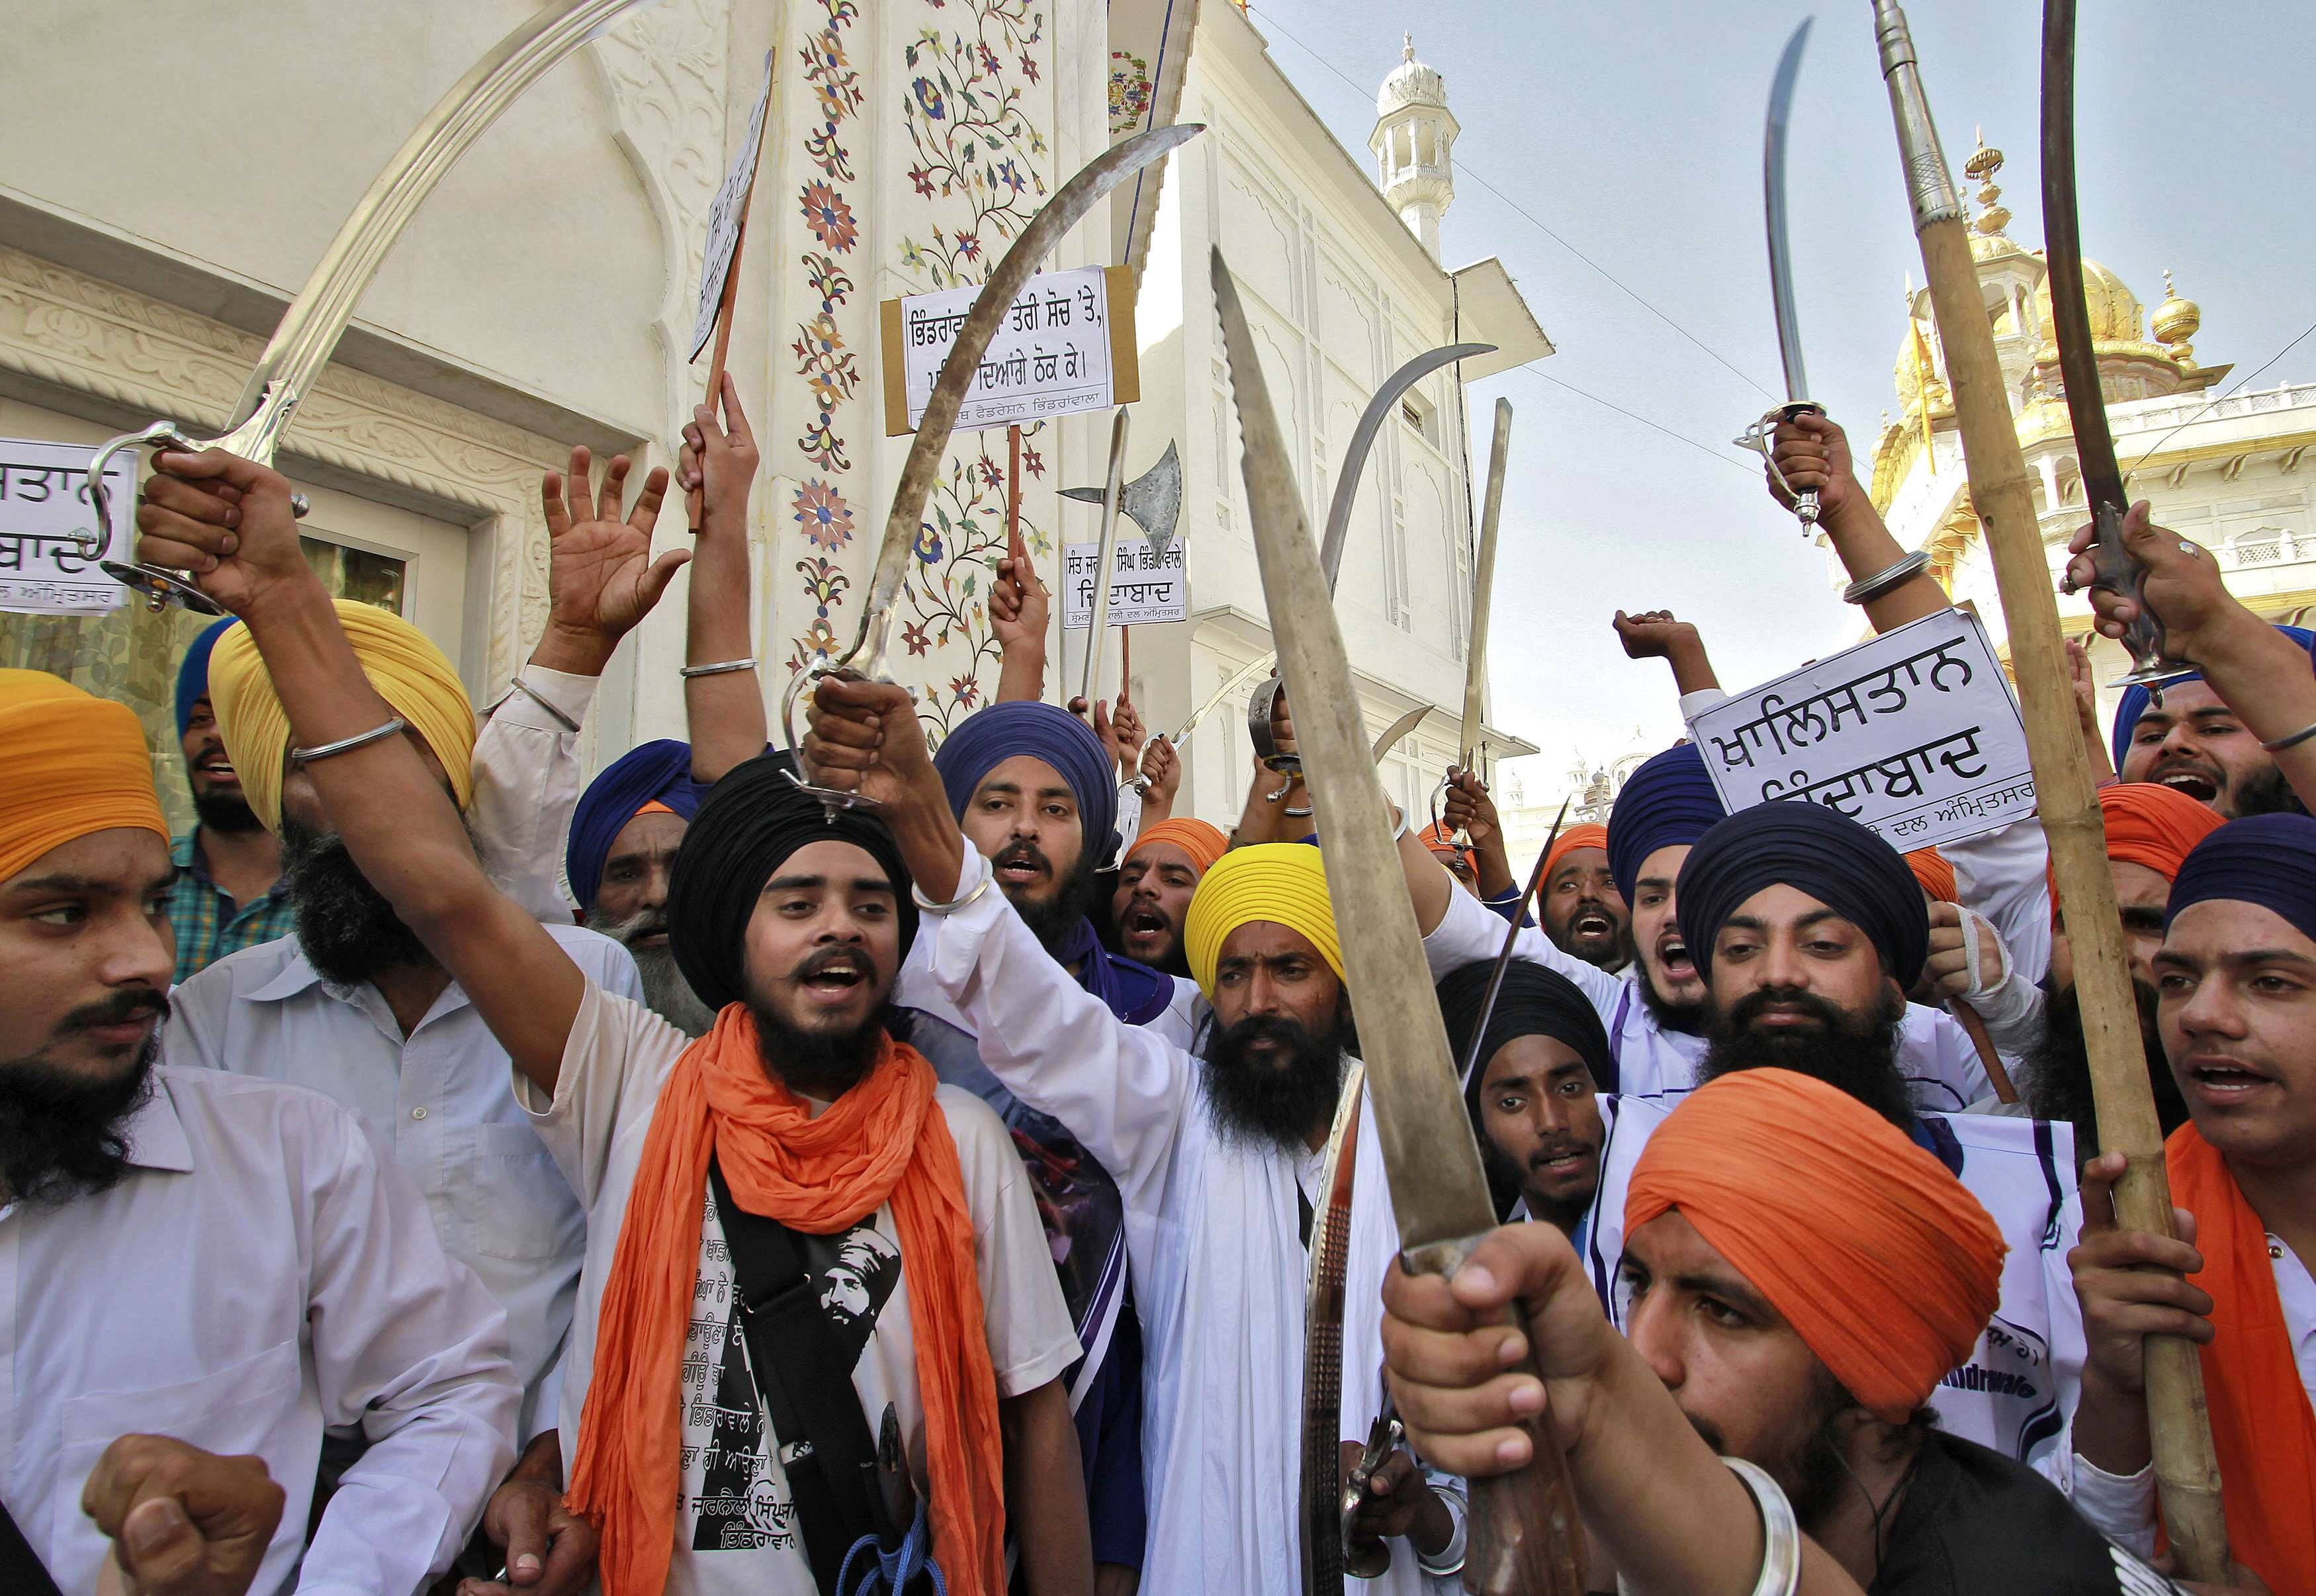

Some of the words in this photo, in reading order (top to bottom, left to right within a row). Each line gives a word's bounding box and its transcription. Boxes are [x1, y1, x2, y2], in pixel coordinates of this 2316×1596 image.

[1046, 288, 1071, 327] ਸੋਚ
[1034, 343, 1058, 382] ਠੋਕ
[1068, 550, 1082, 574] ਸੰਤ
[1117, 547, 1135, 572] ਸਿੰਘ
[1711, 636, 1971, 772] ਖ਼ਾਲਿਸਤਾਨ
[1891, 815, 1928, 837] ਦਲ
